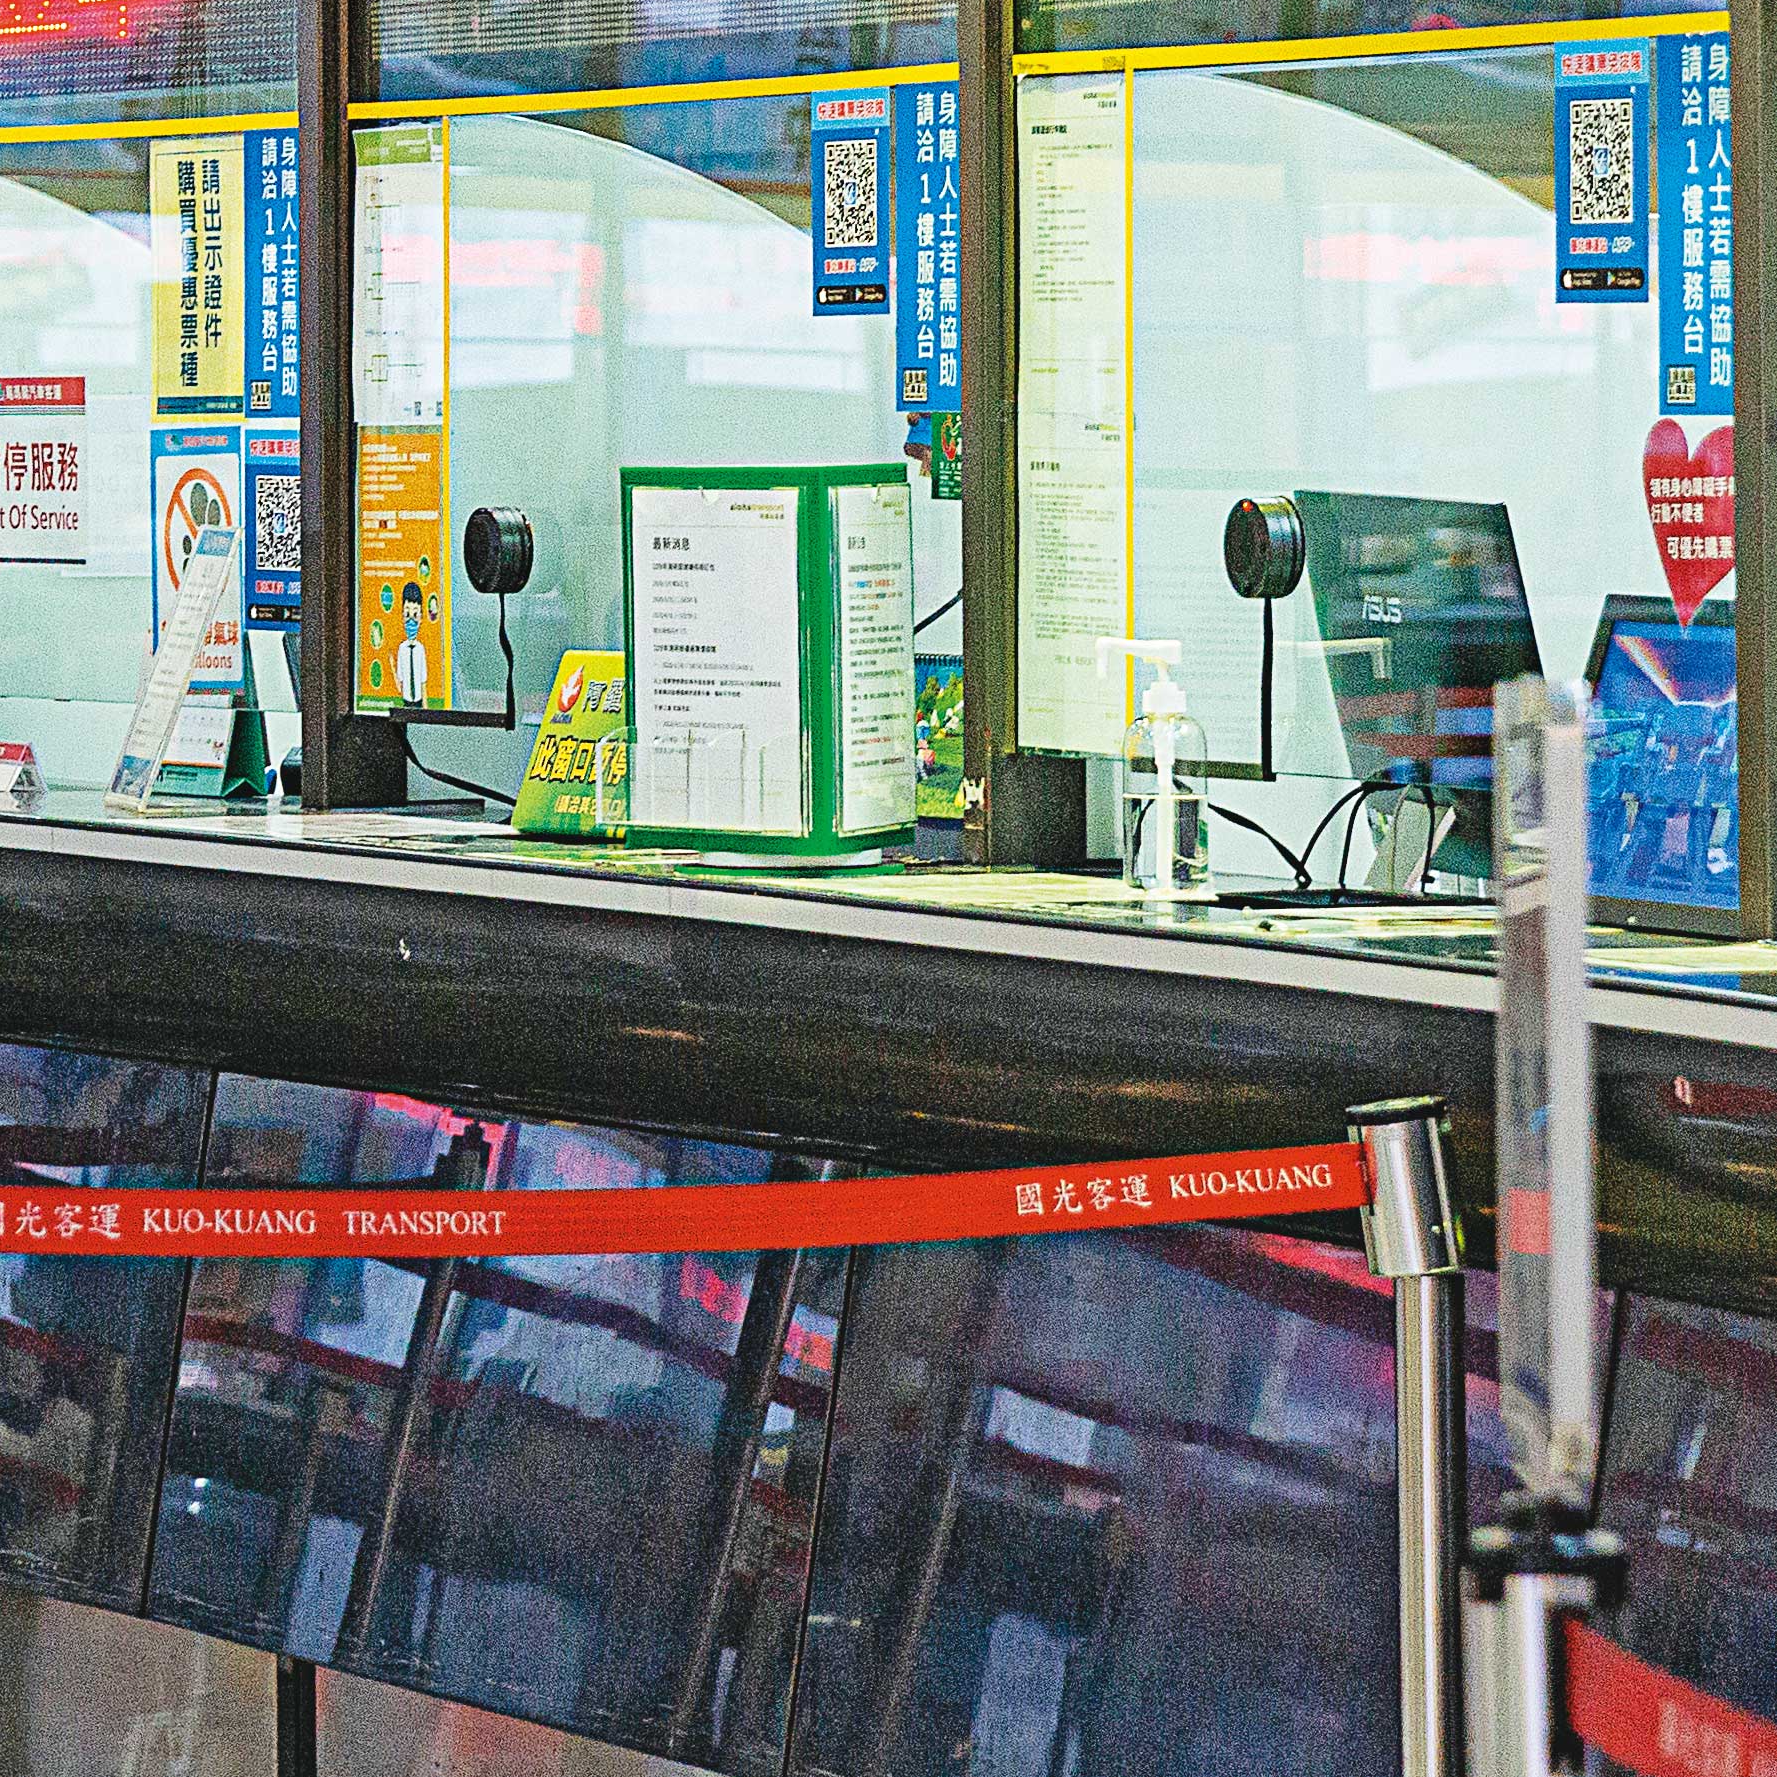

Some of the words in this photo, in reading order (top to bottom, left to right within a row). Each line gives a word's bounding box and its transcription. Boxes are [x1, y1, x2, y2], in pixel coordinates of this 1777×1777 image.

[177, 159, 199, 388] 購買優惠票種
[203, 159, 221, 347] 請出示證件
[263, 138, 277, 371] 請洽1樓服務台
[282, 138, 297, 396] 身障人士若需協助
[918, 93, 934, 358] 請洽1樓服務台
[938, 90, 958, 389] 身障人士若需協助
[1680, 44, 1705, 356] 請洽1樓服務台
[1708, 41, 1732, 388] 身障人士若需協助
[9, 504, 27, 531] Of
[31, 504, 79, 532] Service
[653, 537, 689, 550] 最新消息
[1361, 595, 1404, 626] ASUS
[141, 1205, 317, 1236] KUO-KUANG
[342, 1208, 507, 1239] TRANSPORT
[1014, 1172, 1151, 1217] 國光客運
[1169, 1161, 1333, 1201] KUO-KUANG
